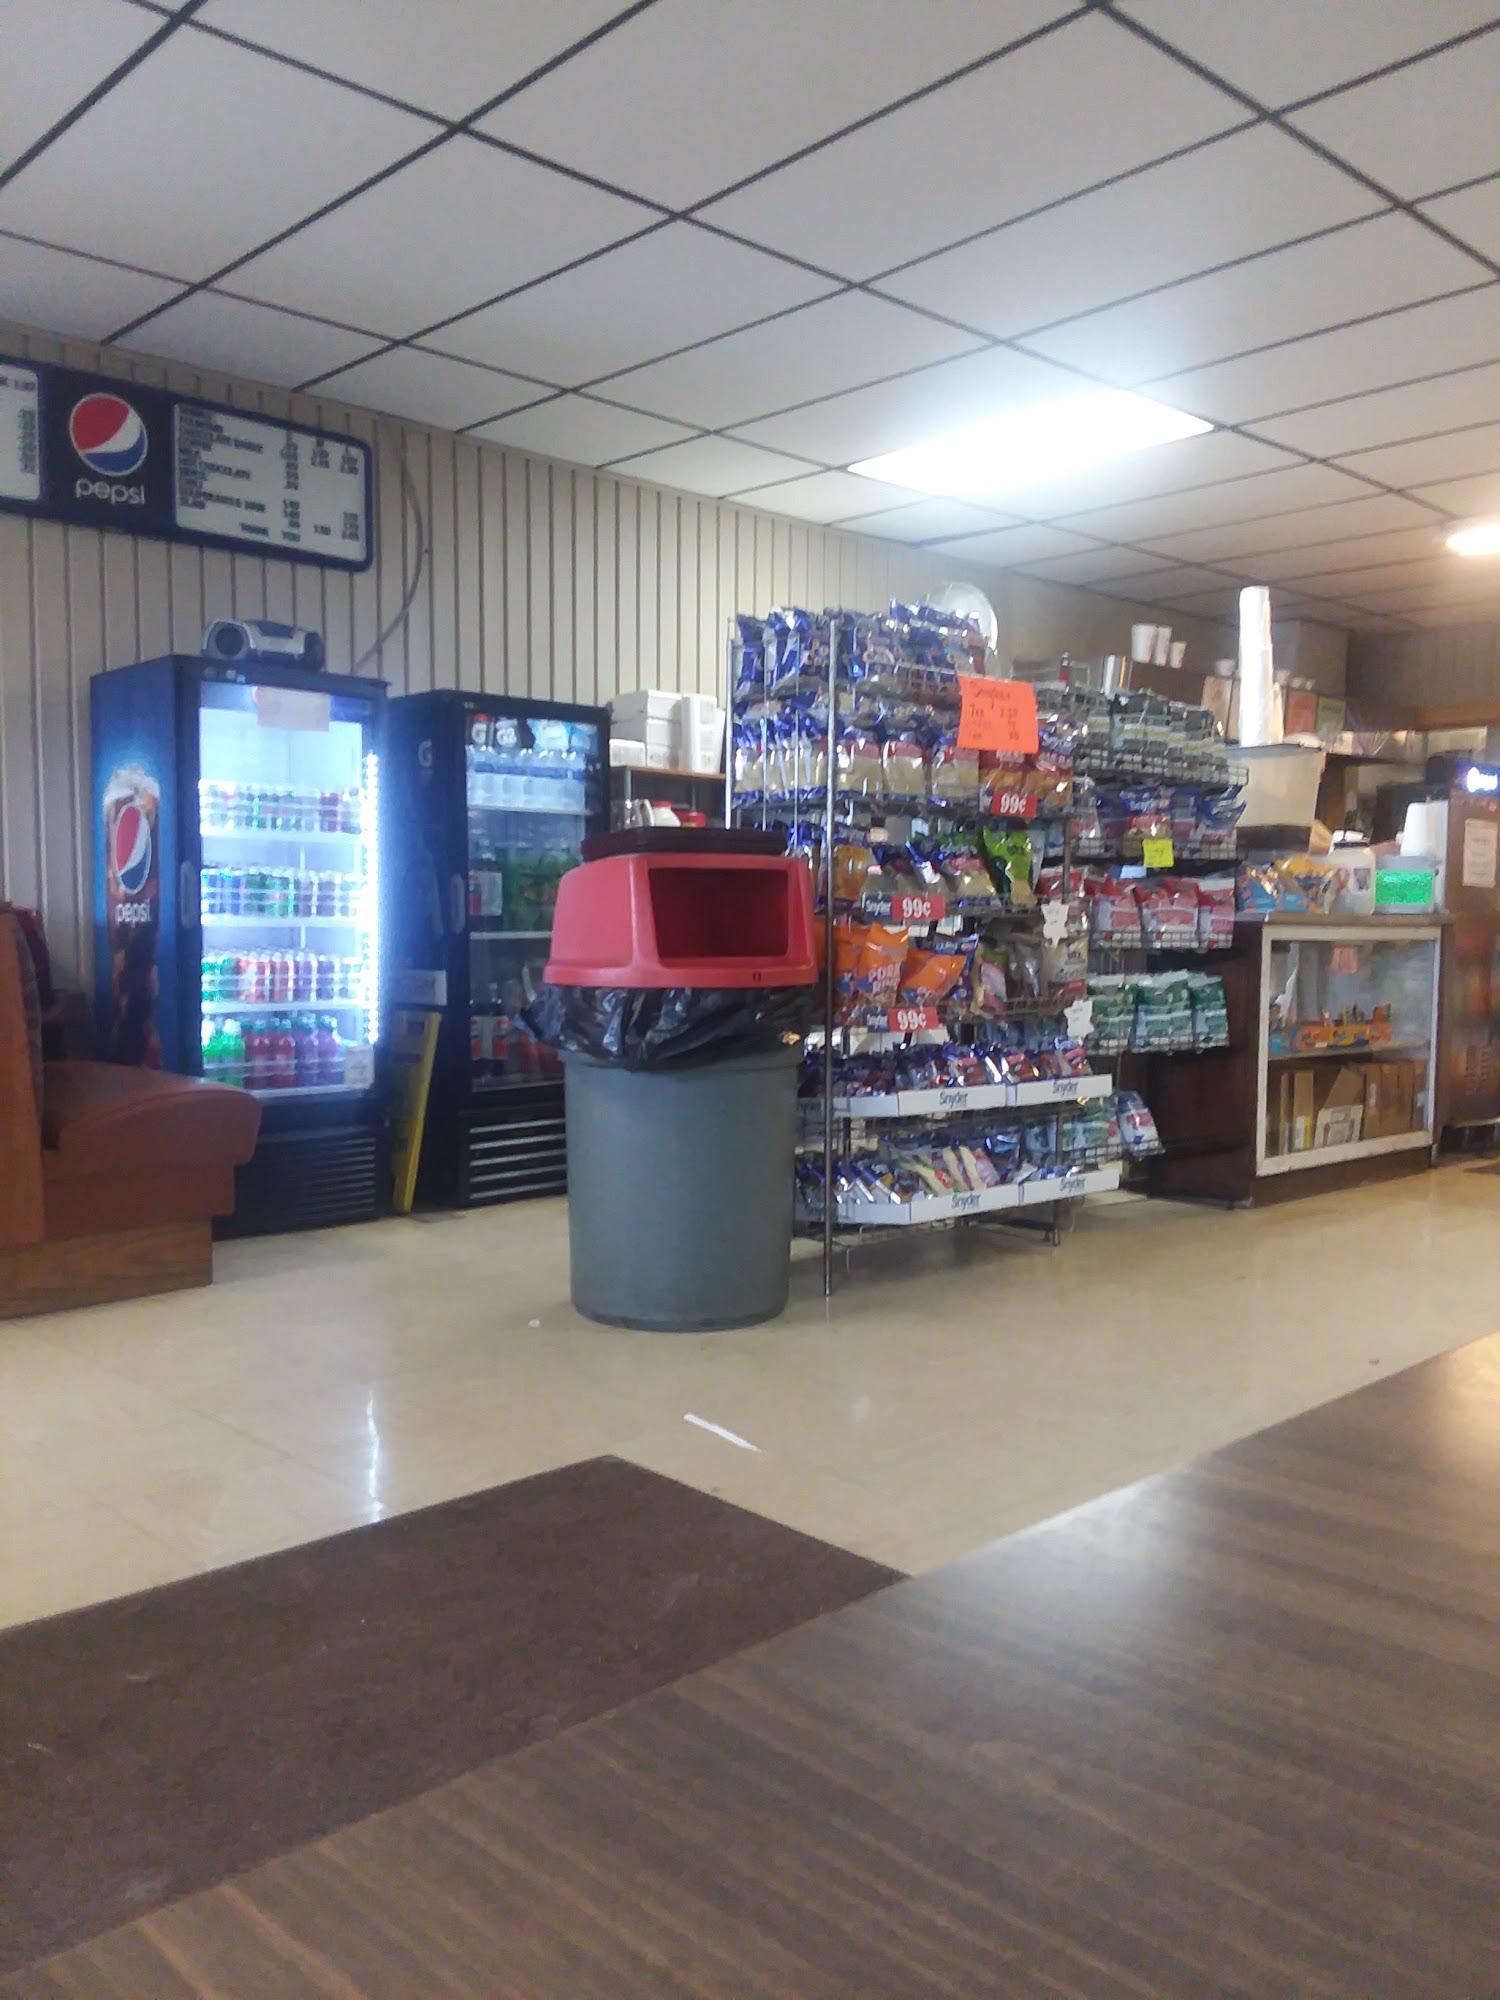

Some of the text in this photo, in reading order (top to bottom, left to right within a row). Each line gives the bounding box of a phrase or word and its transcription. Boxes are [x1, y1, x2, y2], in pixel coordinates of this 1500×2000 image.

[76, 479, 145, 504] pepsi
[1000, 793, 1028, 815] 99¢
[115, 899, 150, 928] pepsi
[902, 897, 931, 918] 99¢
[897, 1010, 926, 1031] 99¢
[940, 1091, 968, 1108] Snyder
